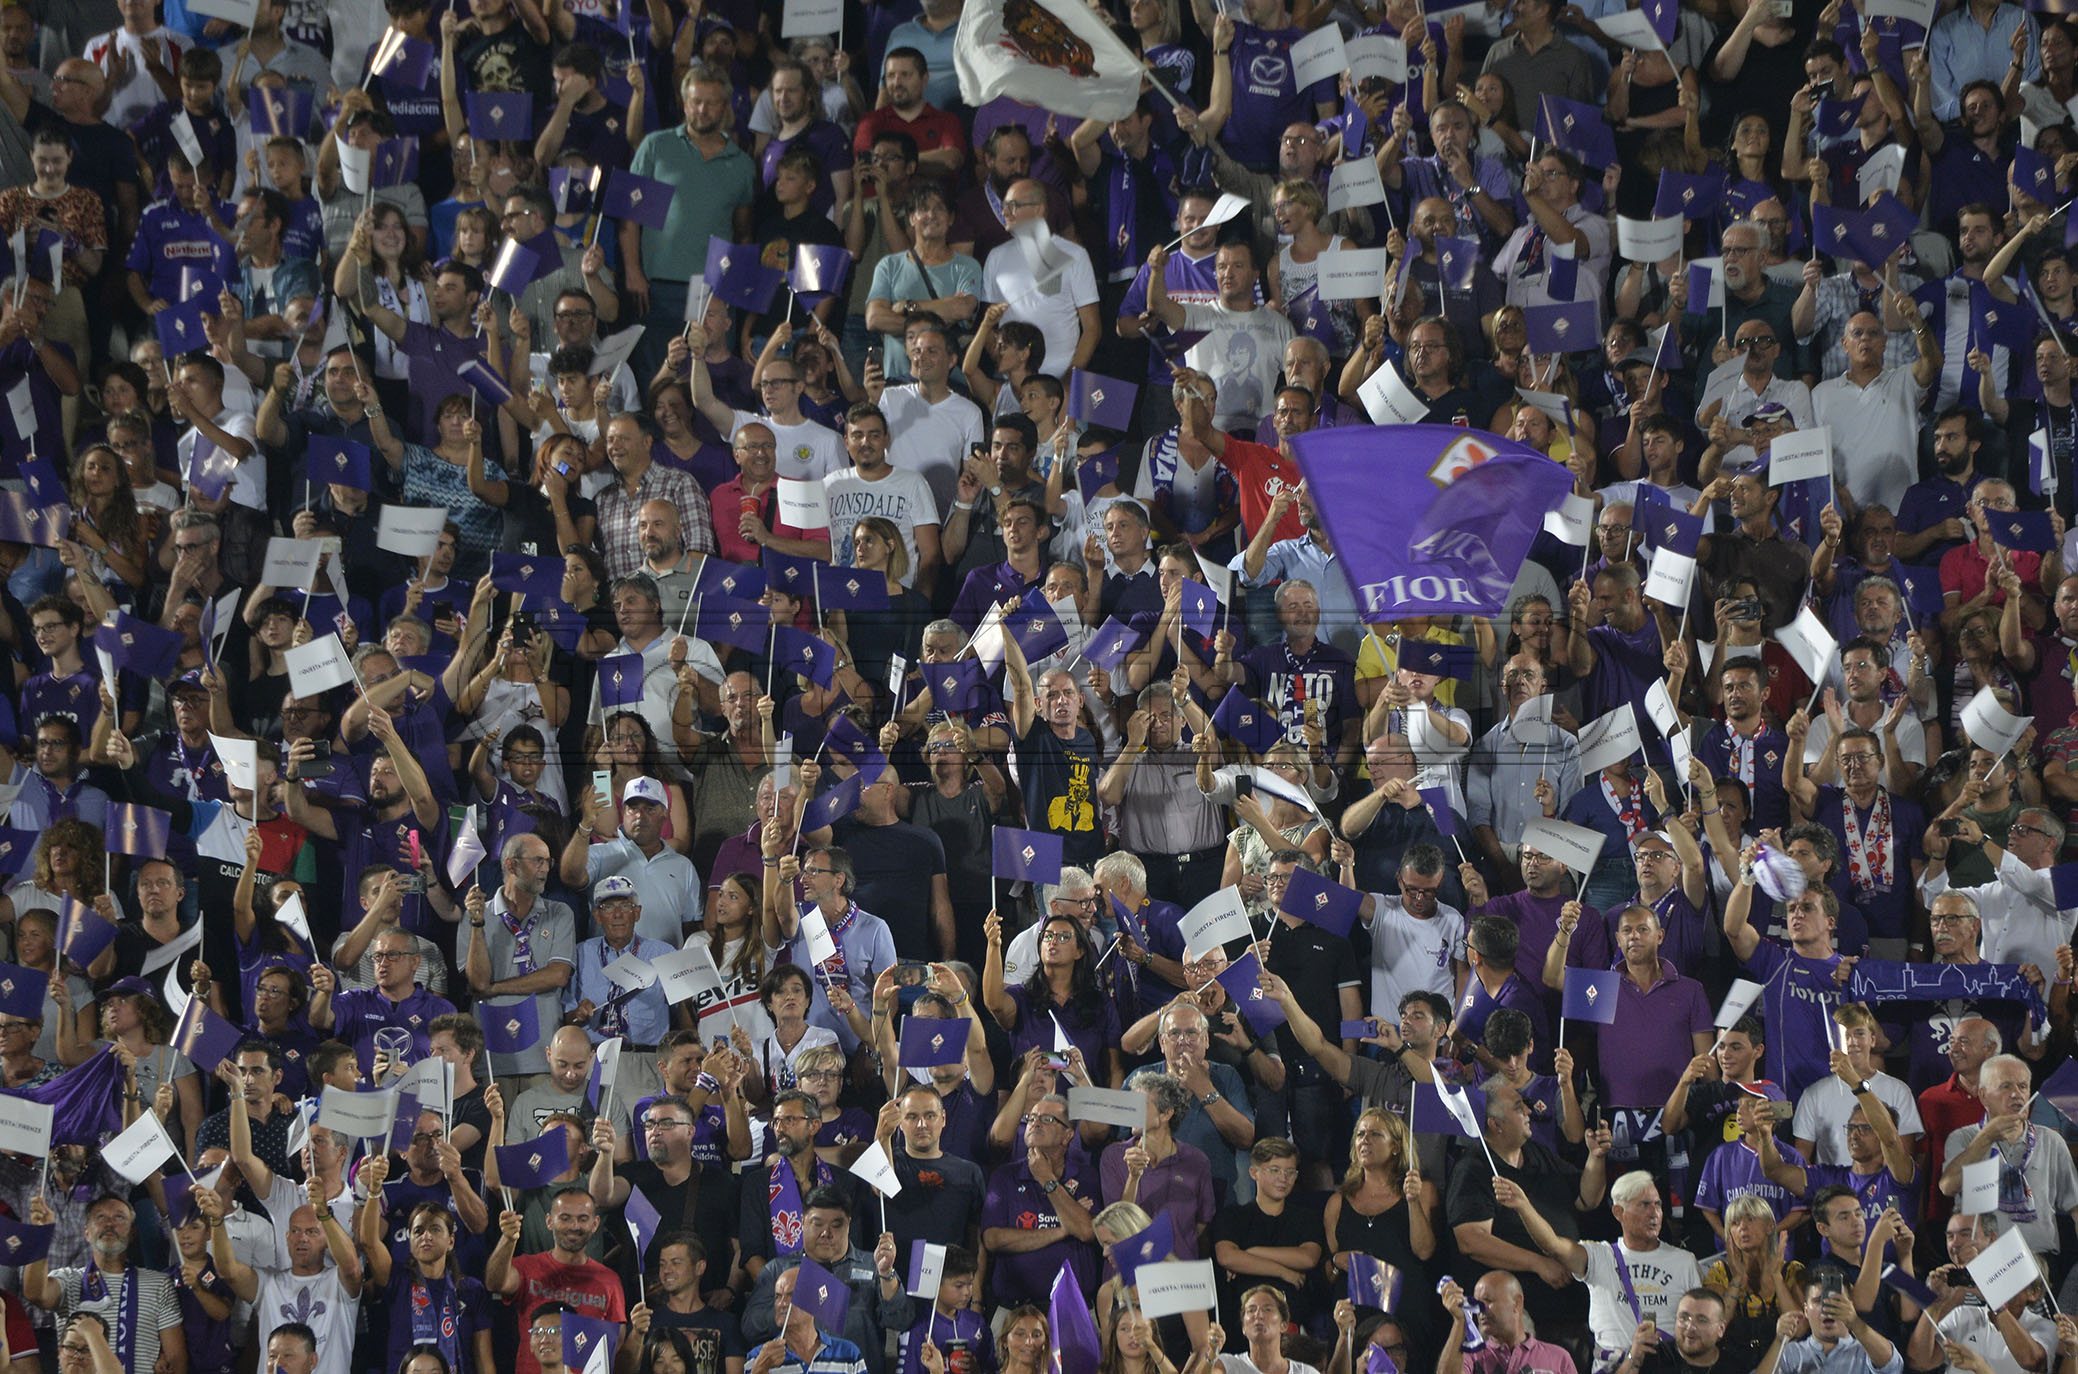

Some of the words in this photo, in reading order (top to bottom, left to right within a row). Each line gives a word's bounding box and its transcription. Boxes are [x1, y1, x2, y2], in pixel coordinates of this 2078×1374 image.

[386, 100, 440, 115] ediacom
[829, 492, 906, 520] LONSDALE
[1214, 910, 1237, 923] FIRENZE
[1788, 981, 1842, 1006] TOYOT
[2007, 1252, 2025, 1269] FIRENZ
[1615, 1263, 1673, 1286] THY'S
[528, 1279, 607, 1312] Desigual
[1643, 1295, 1668, 1306] TEAM
